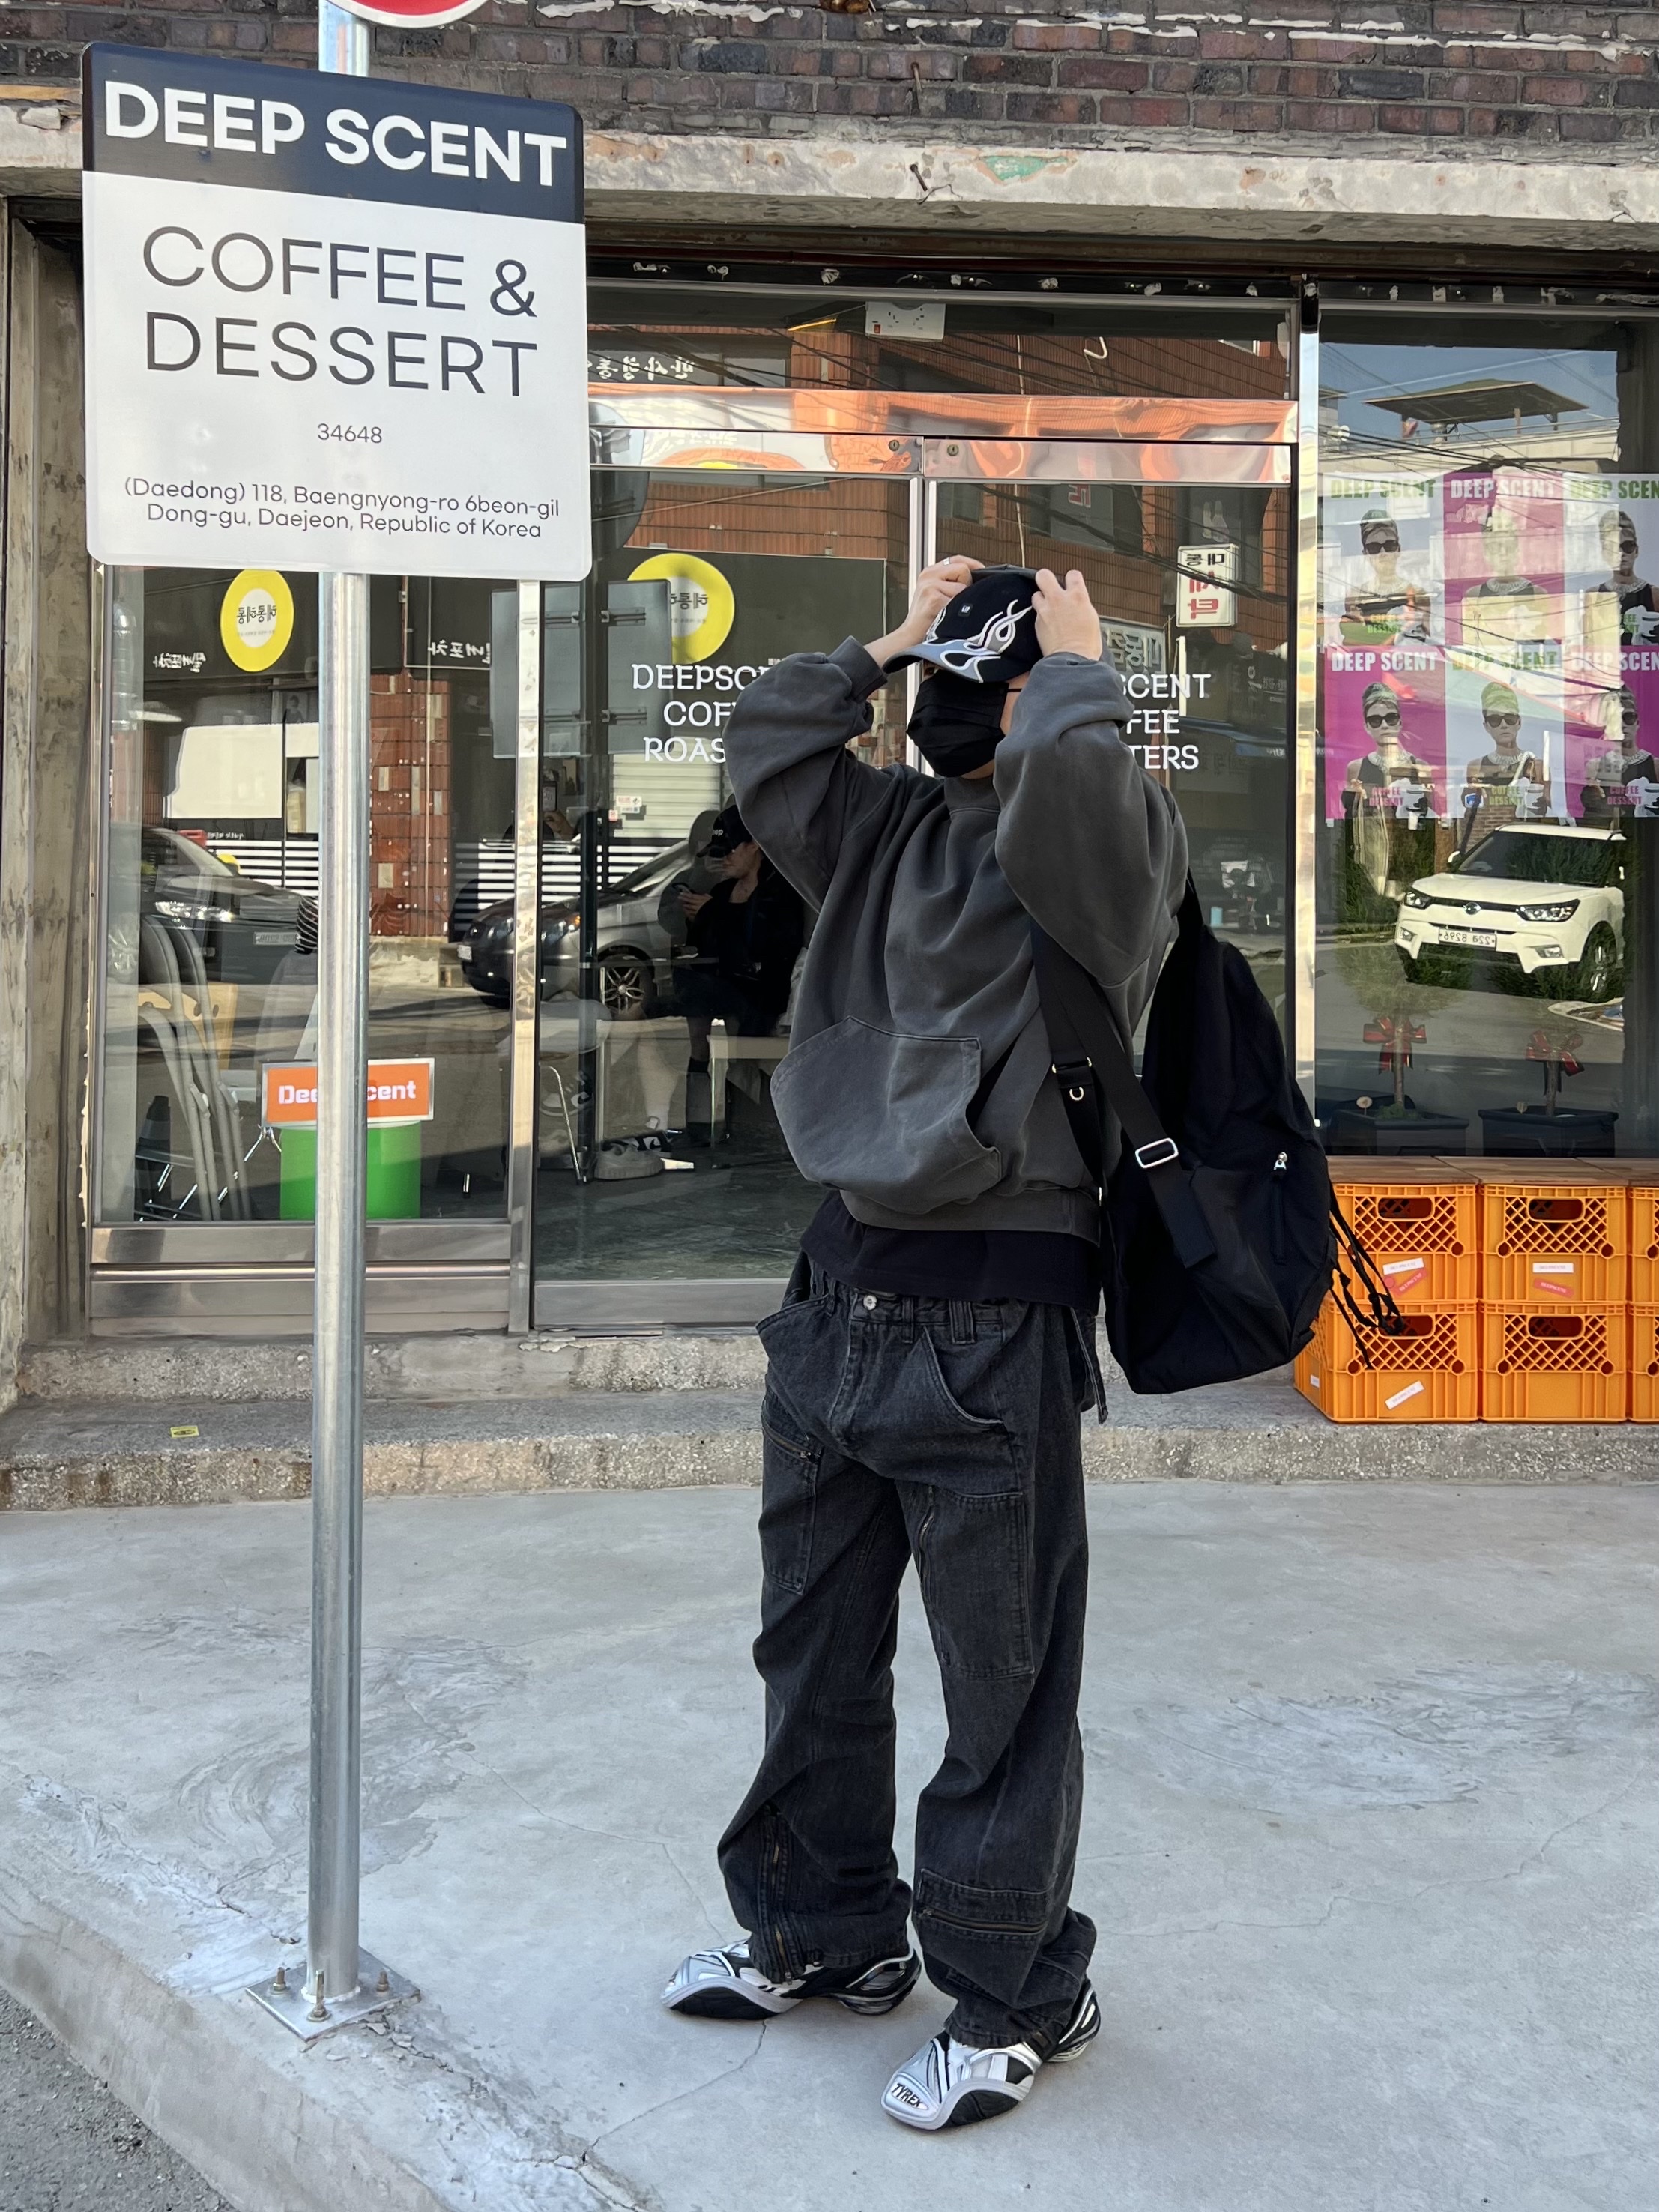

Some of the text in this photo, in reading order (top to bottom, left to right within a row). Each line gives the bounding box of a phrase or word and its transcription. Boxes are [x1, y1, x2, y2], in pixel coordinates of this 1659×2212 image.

[105, 80, 566, 187] DEEP SCENT
[143, 226, 537, 318] COFFEE &
[145, 312, 537, 397] DESSERT
[317, 423, 383, 444] 34648
[124, 477, 559, 520] (Daedong) 118, Baengnyong-ro 6beon-gil
[1330, 479, 1371, 498] DEEP
[1451, 479, 1555, 498] DEEP SCENT
[148, 503, 541, 538] Dong-gu, Daejeon, Republic of Korea
[1332, 652, 1438, 671] DEEP SCENT
[892, 2082, 923, 2108] TYREX
